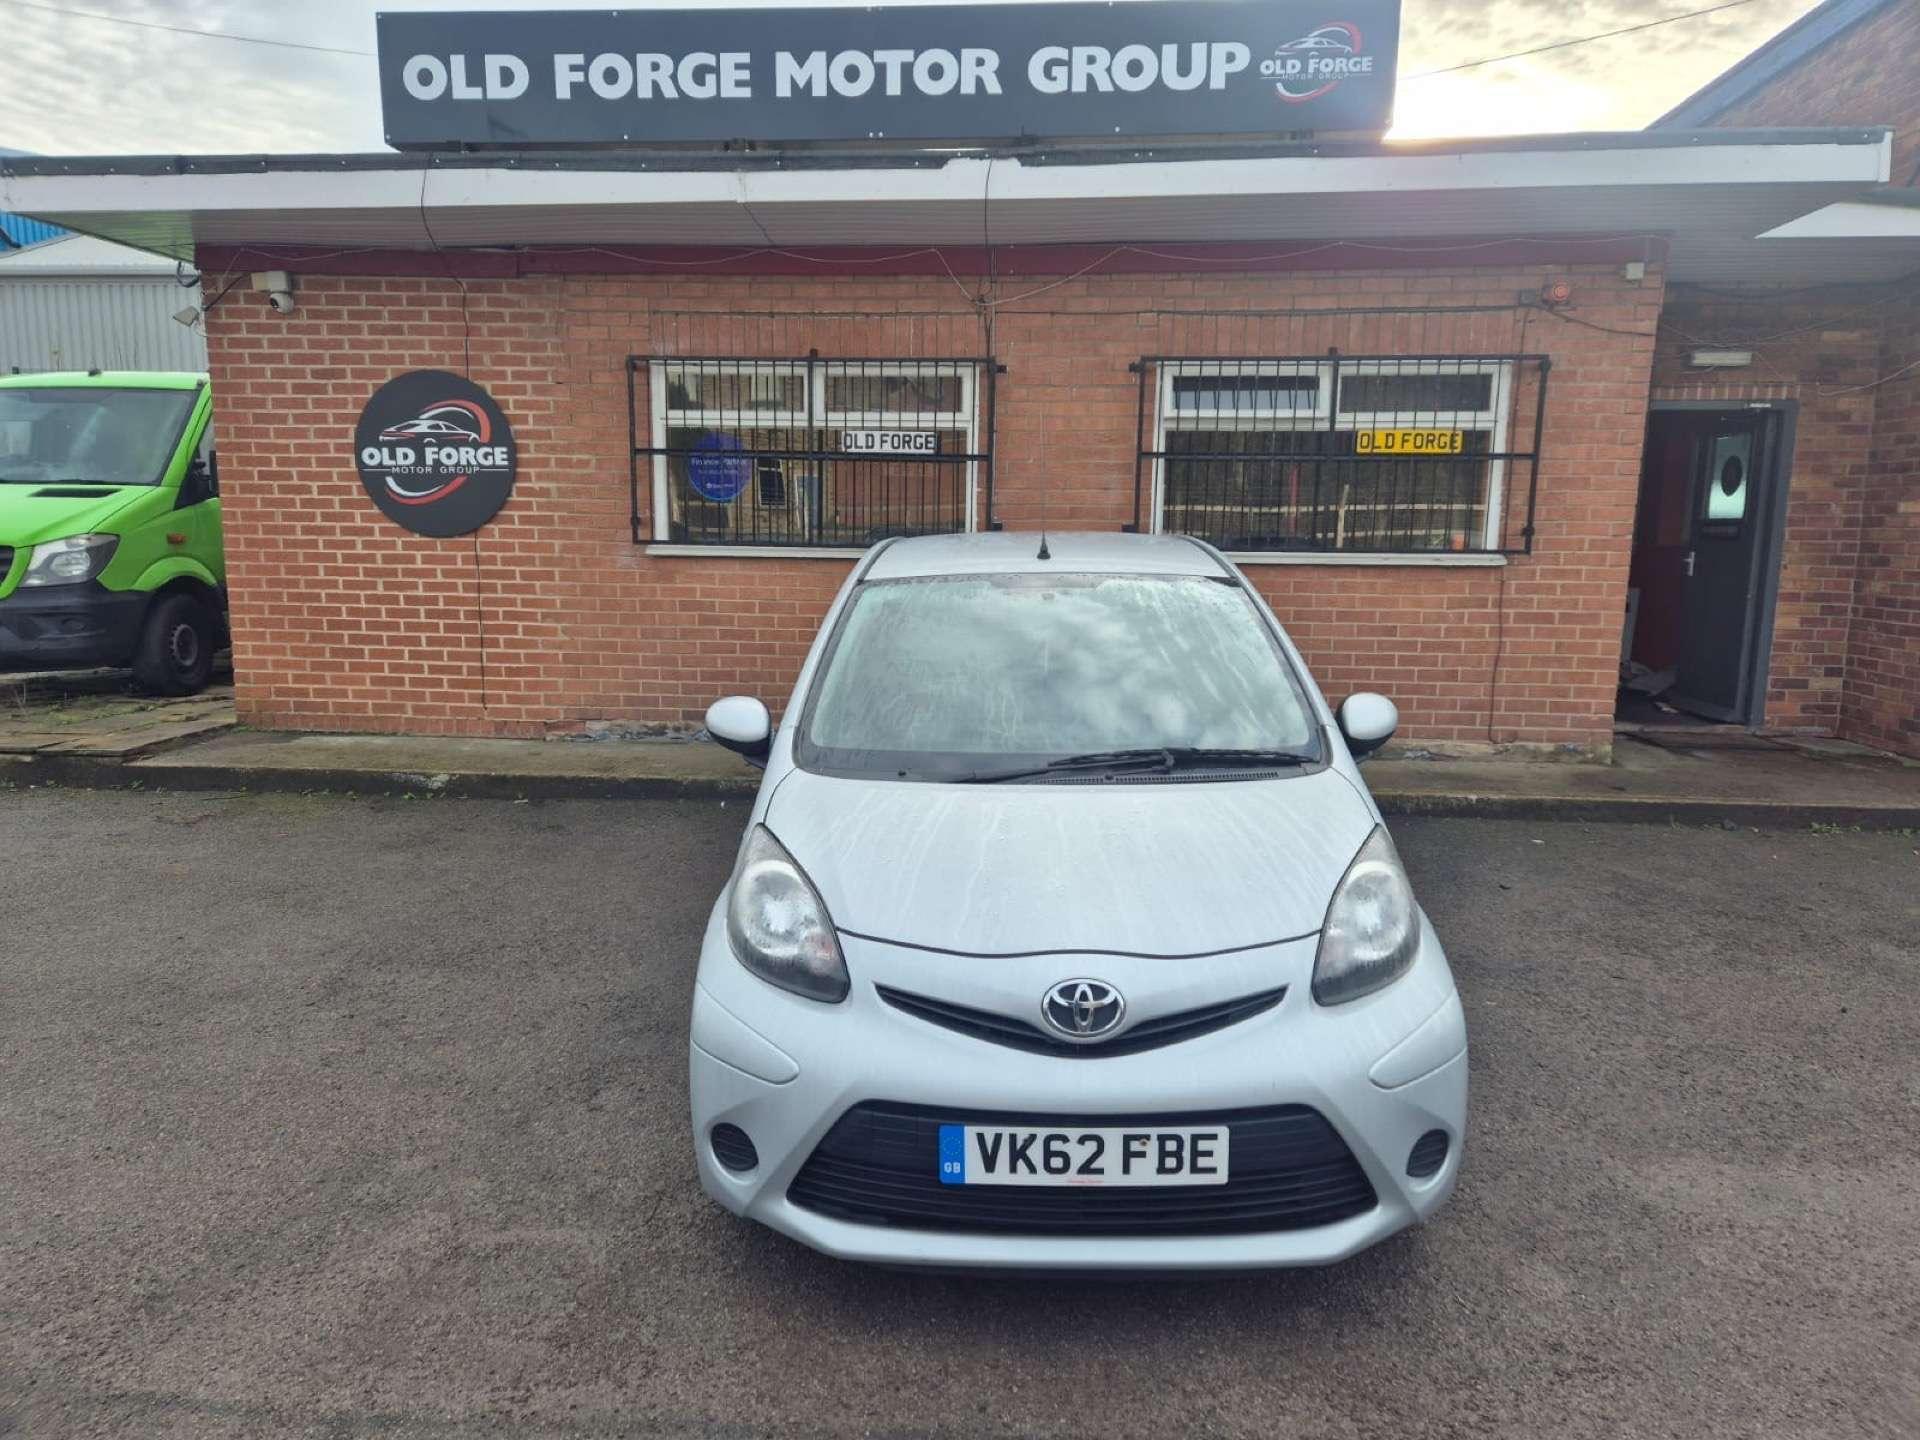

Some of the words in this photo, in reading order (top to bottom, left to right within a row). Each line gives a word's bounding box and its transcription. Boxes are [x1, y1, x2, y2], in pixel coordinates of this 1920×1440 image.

[403, 54, 529, 100] OLD
[553, 52, 751, 99] FORGE
[775, 48, 1002, 98] MOTOR
[1027, 41, 1251, 94] GROUP
[1260, 59, 1301, 75] OLD
[1308, 56, 1373, 73] FORGE
[844, 433, 875, 449] OLD
[880, 433, 936, 450] FORGE
[1360, 432, 1395, 449] OLD
[1401, 432, 1459, 449] FORGE
[361, 447, 416, 466] OLD
[425, 447, 509, 466] FORGE
[391, 466, 433, 474] MOTOR
[440, 466, 480, 474] GROUP
[976, 1132, 1105, 1176] VK62
[1122, 1133, 1219, 1176] FBE
[944, 1162, 960, 1174] GB
